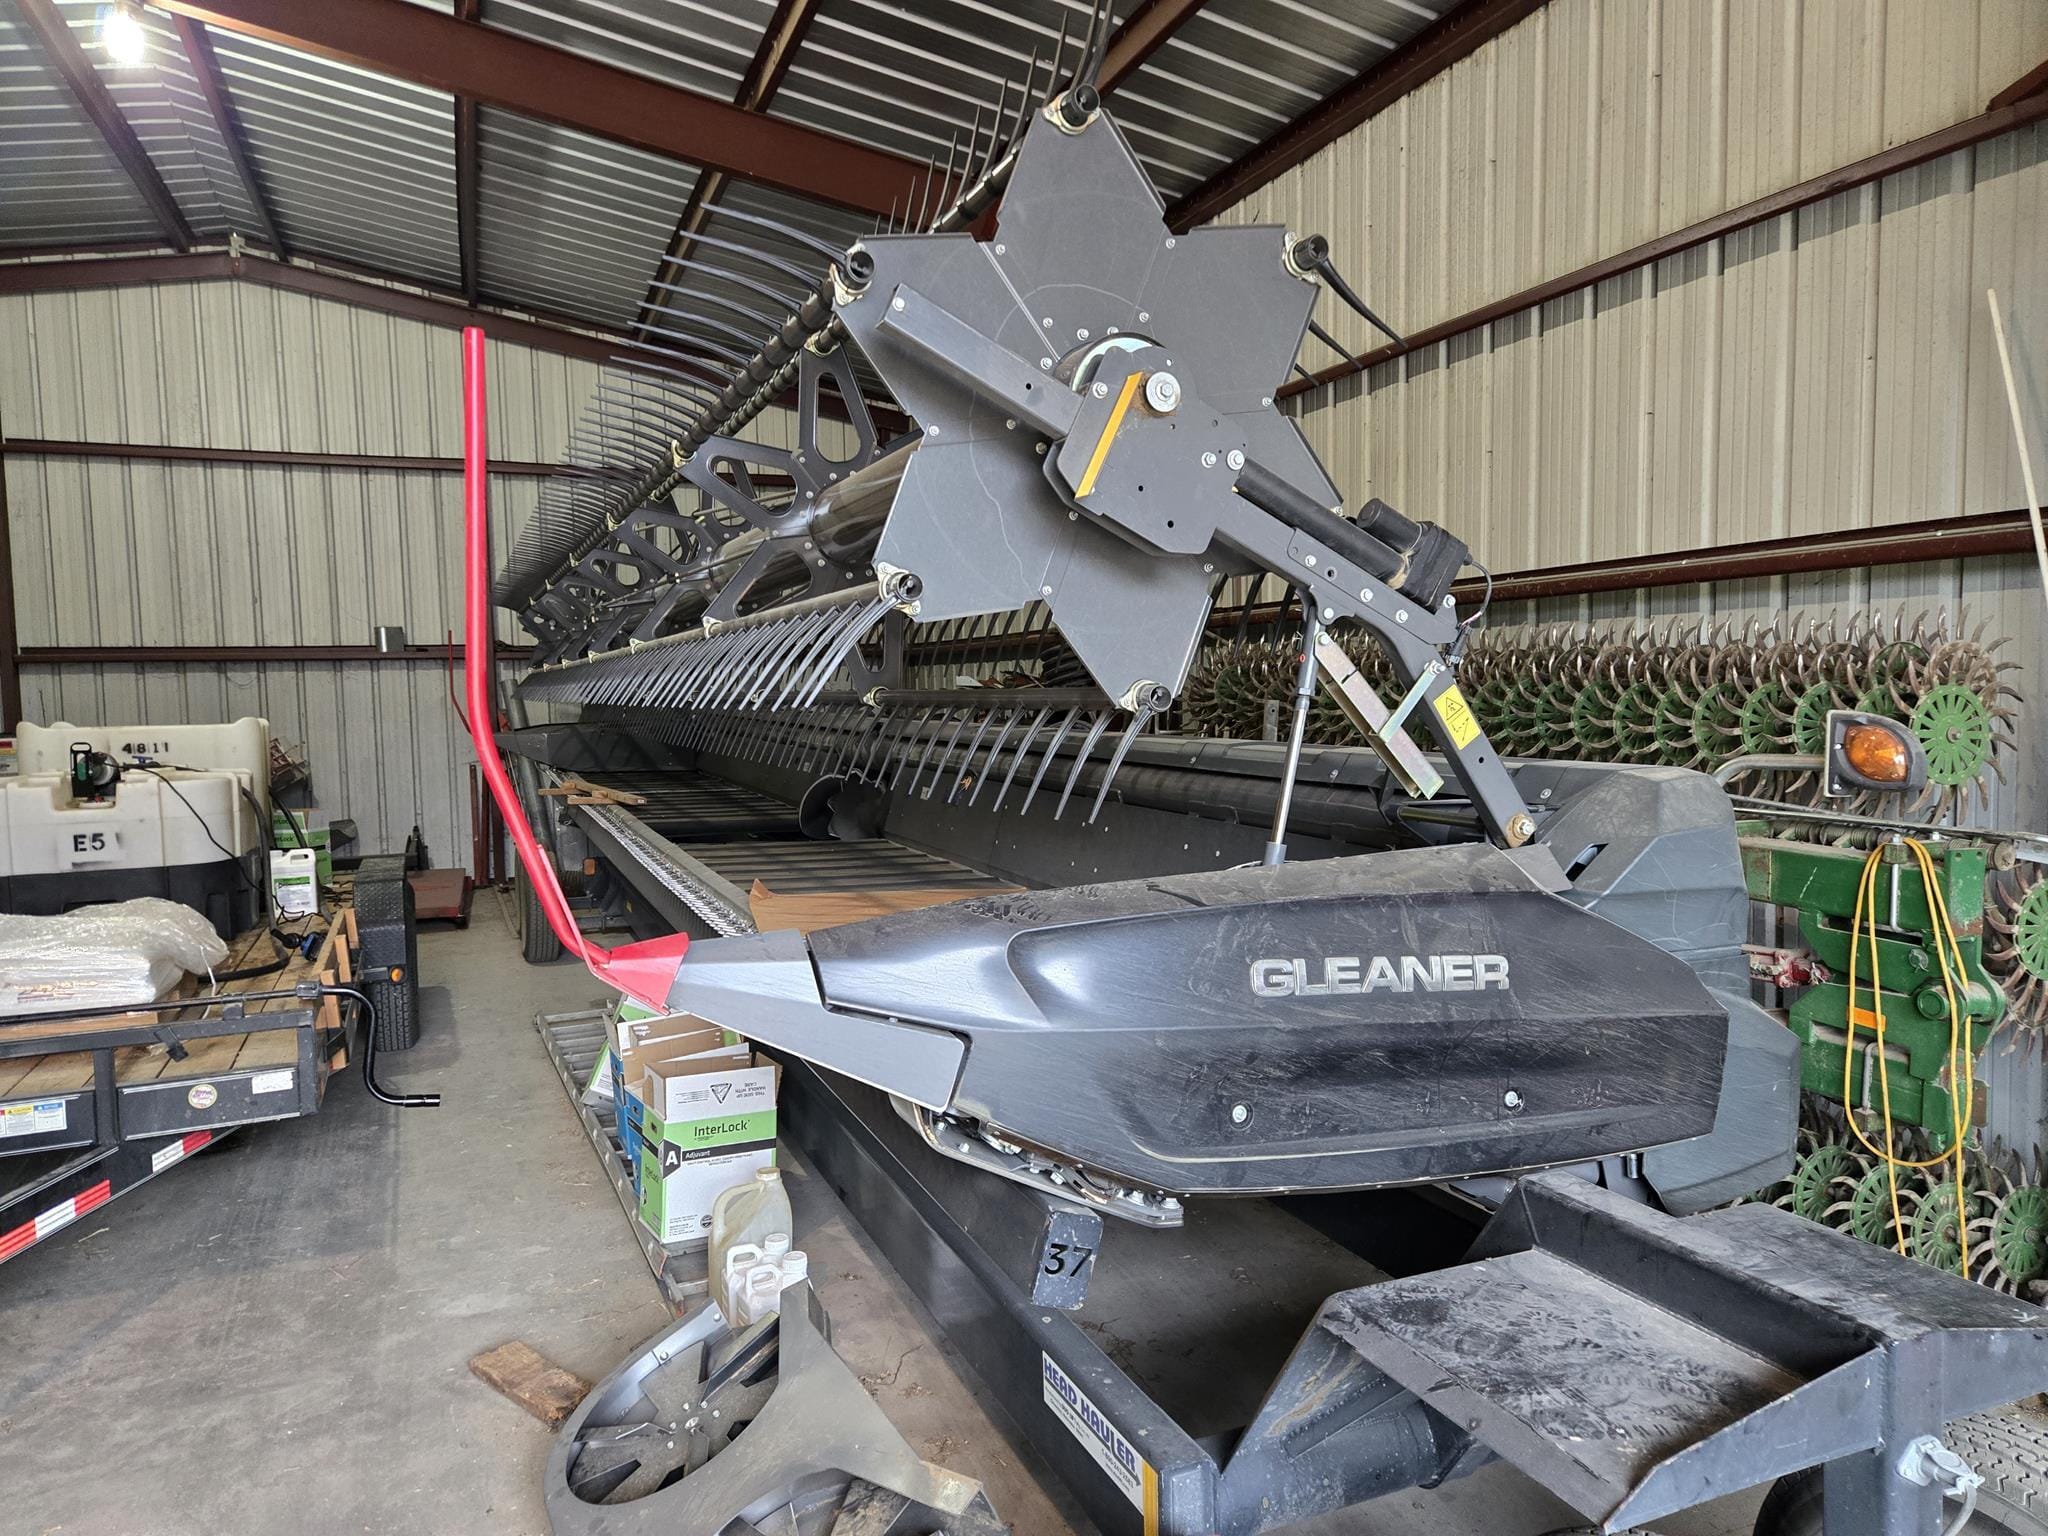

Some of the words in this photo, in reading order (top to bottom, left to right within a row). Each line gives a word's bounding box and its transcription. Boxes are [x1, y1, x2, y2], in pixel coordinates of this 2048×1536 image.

[122, 742, 168, 754] 4811
[73, 833, 105, 852] E5
[1250, 954, 1510, 998] GLEANER
[694, 1120, 748, 1137] InterLock
[665, 1151, 679, 1167] A
[685, 1150, 711, 1160] Adjuvant
[1045, 1243, 1093, 1277] 37
[1044, 1358, 1078, 1405] HEAD
[1081, 1398, 1136, 1474] HAULER
